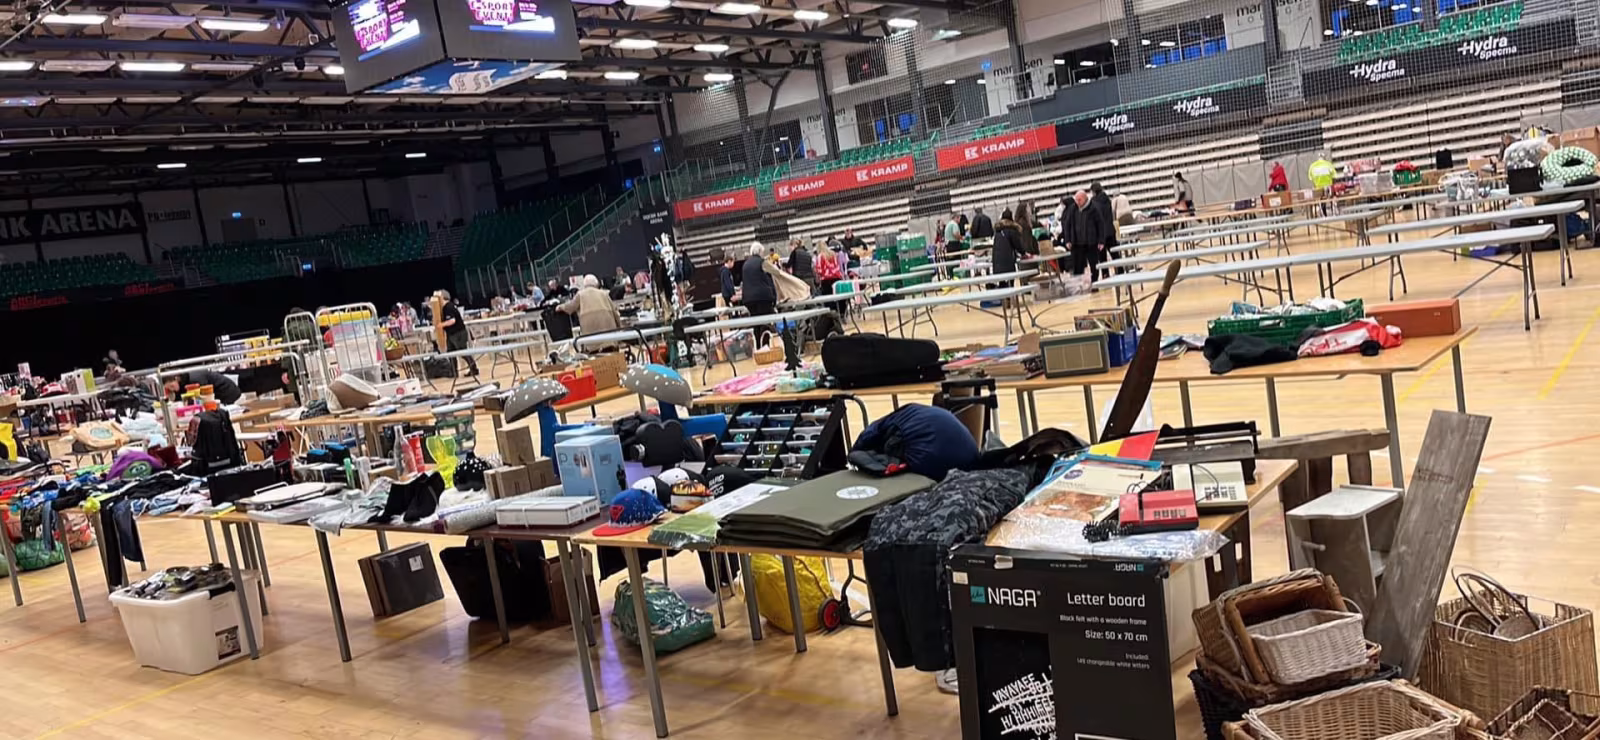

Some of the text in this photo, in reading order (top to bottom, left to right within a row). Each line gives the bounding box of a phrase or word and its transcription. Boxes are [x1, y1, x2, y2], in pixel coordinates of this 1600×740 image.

[1458, 36, 1508, 57] Hydra
[1479, 45, 1517, 60] Specma
[1350, 59, 1396, 79] Hydra
[1370, 68, 1405, 83] Specma
[1173, 96, 1212, 114] Hydra
[1191, 104, 1219, 117] Specma
[1092, 113, 1128, 131] Hydra
[1108, 121, 1134, 134] Specma
[981, 138, 1025, 155] KRAMP
[870, 163, 908, 178] KRAMP
[791, 179, 826, 193] KRAMP
[704, 197, 735, 210] KRAMP
[41, 208, 137, 235] ARENA
[1067, 592, 1146, 608] Letter board
[1059, 614, 1075, 622] Black
[1105, 617, 1129, 625] wooden
[1129, 617, 1147, 626] frame
[1085, 629, 1148, 643] Size: 50 x 70 cm
